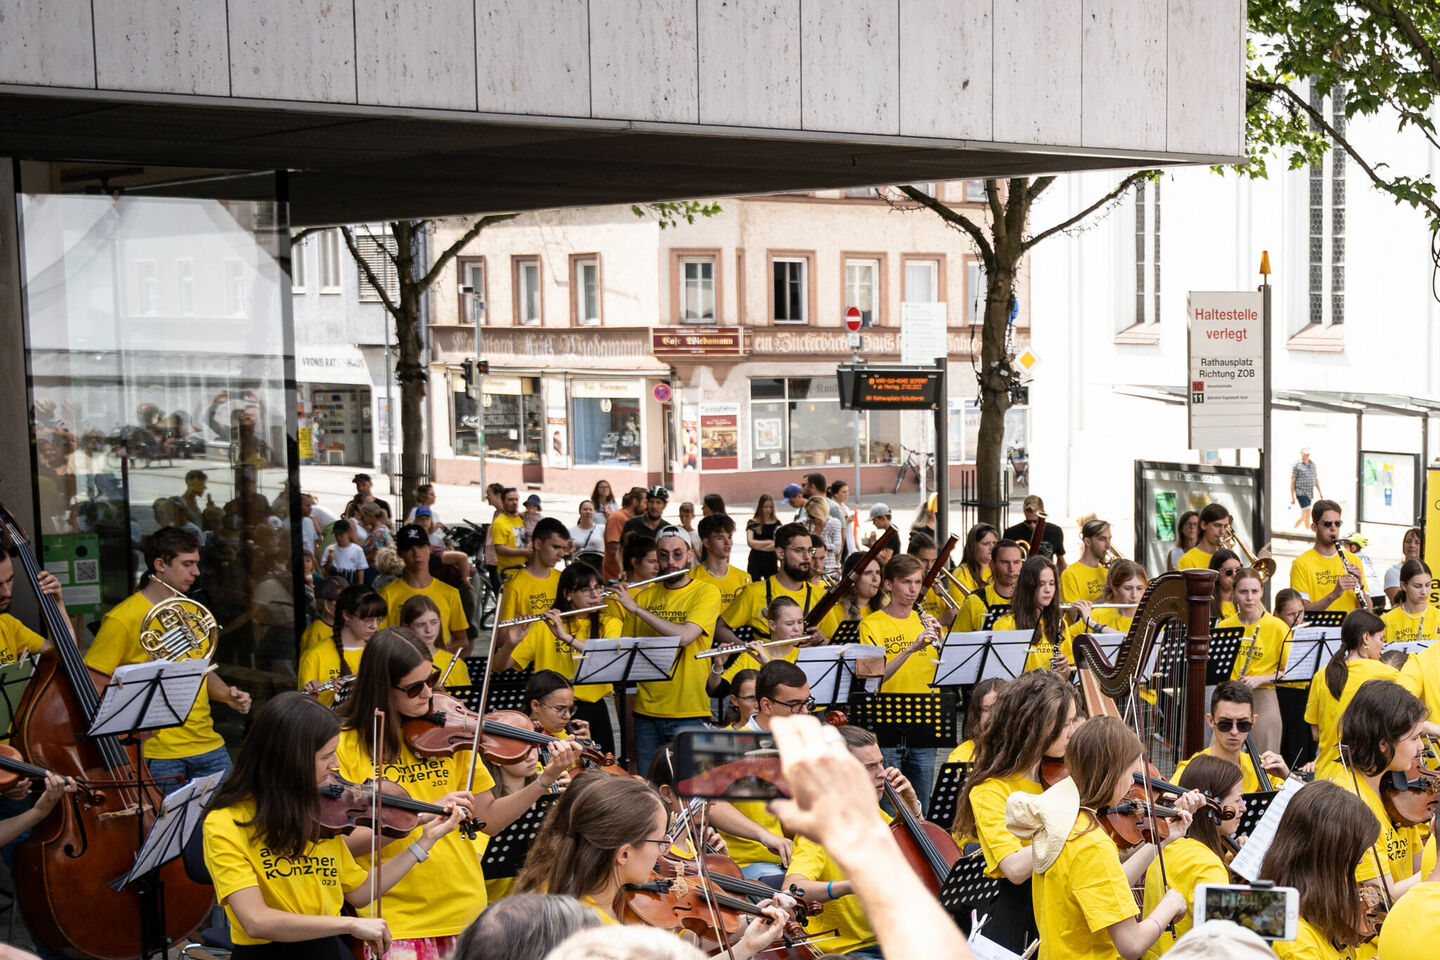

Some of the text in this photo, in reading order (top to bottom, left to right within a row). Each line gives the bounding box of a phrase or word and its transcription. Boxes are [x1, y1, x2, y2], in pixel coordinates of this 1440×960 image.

[1194, 308, 1258, 321] Haltestelle
[1206, 327, 1247, 342] verlegt
[1200, 358, 1254, 369] Rathausplatz
[1199, 369, 1256, 380] Richtung ZOB
[1193, 393, 1204, 403] 11
[883, 634, 905, 643] audi
